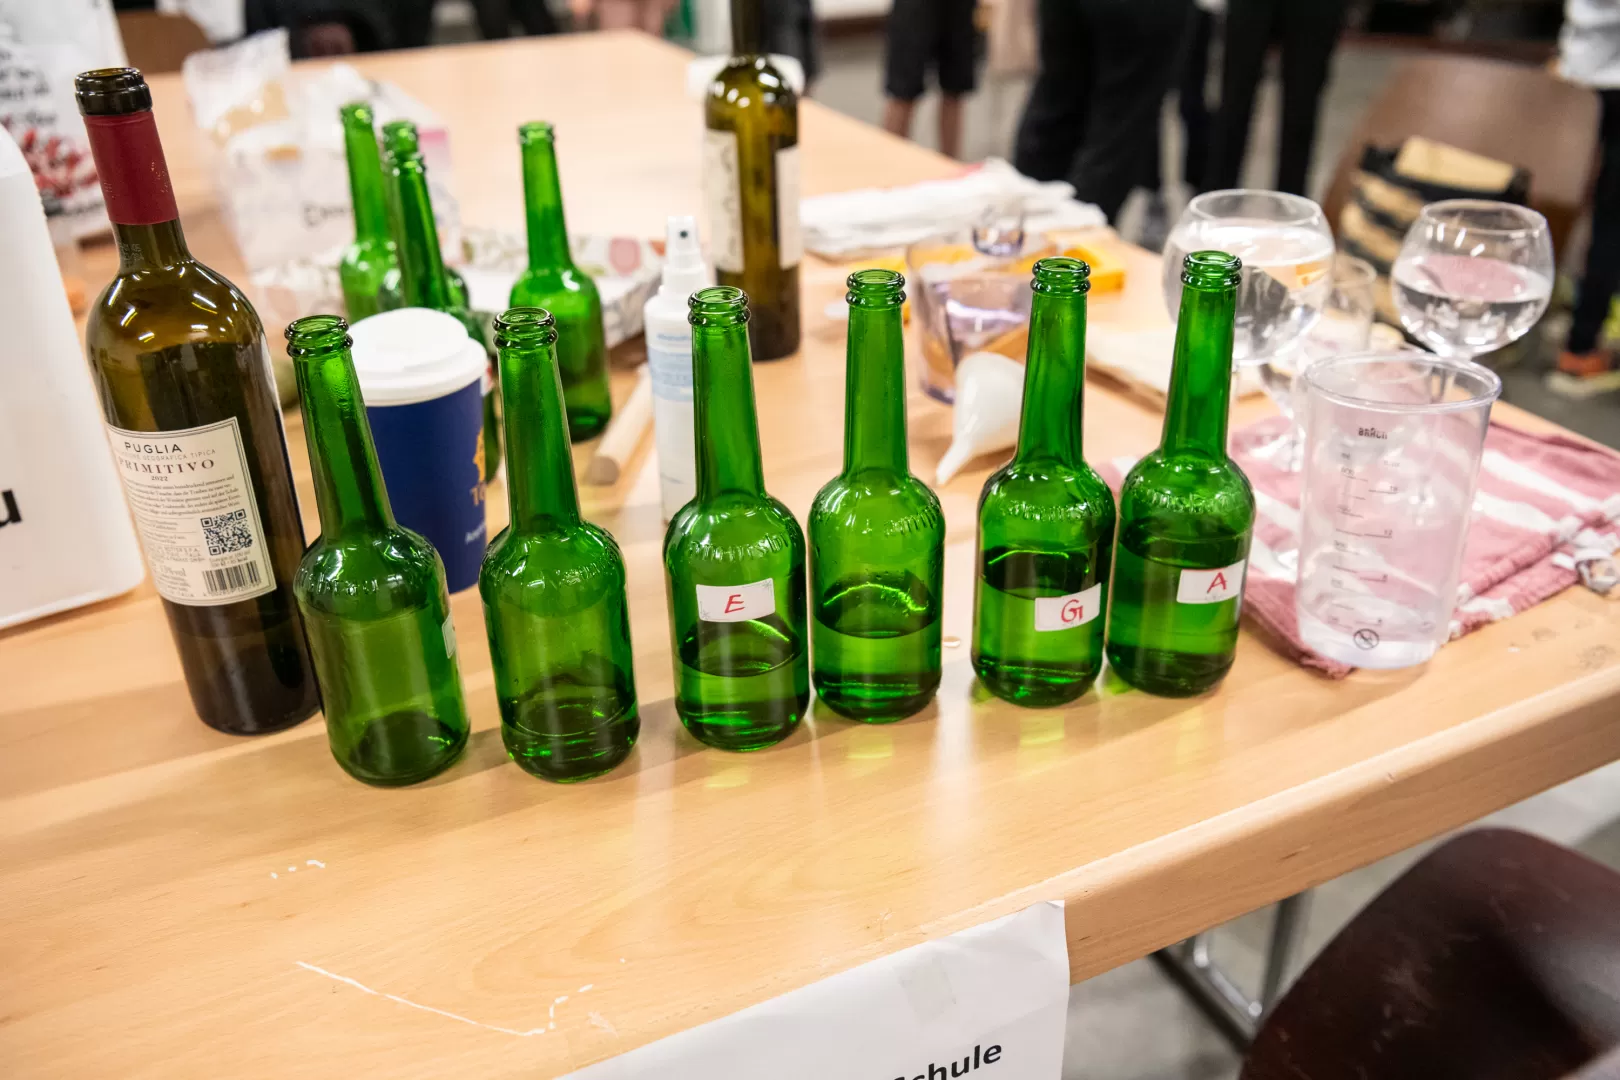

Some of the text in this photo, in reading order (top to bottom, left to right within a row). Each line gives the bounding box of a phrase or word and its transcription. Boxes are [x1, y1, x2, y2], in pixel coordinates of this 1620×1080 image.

[124, 441, 182, 454] PUGLIA
[191, 448, 216, 459] TIPICA
[119, 458, 215, 474] PRIMITIVO
[1207, 572, 1227, 594] A
[724, 594, 745, 613] E
[1061, 599, 1083, 622] G
[893, 1044, 1002, 1080] hule
